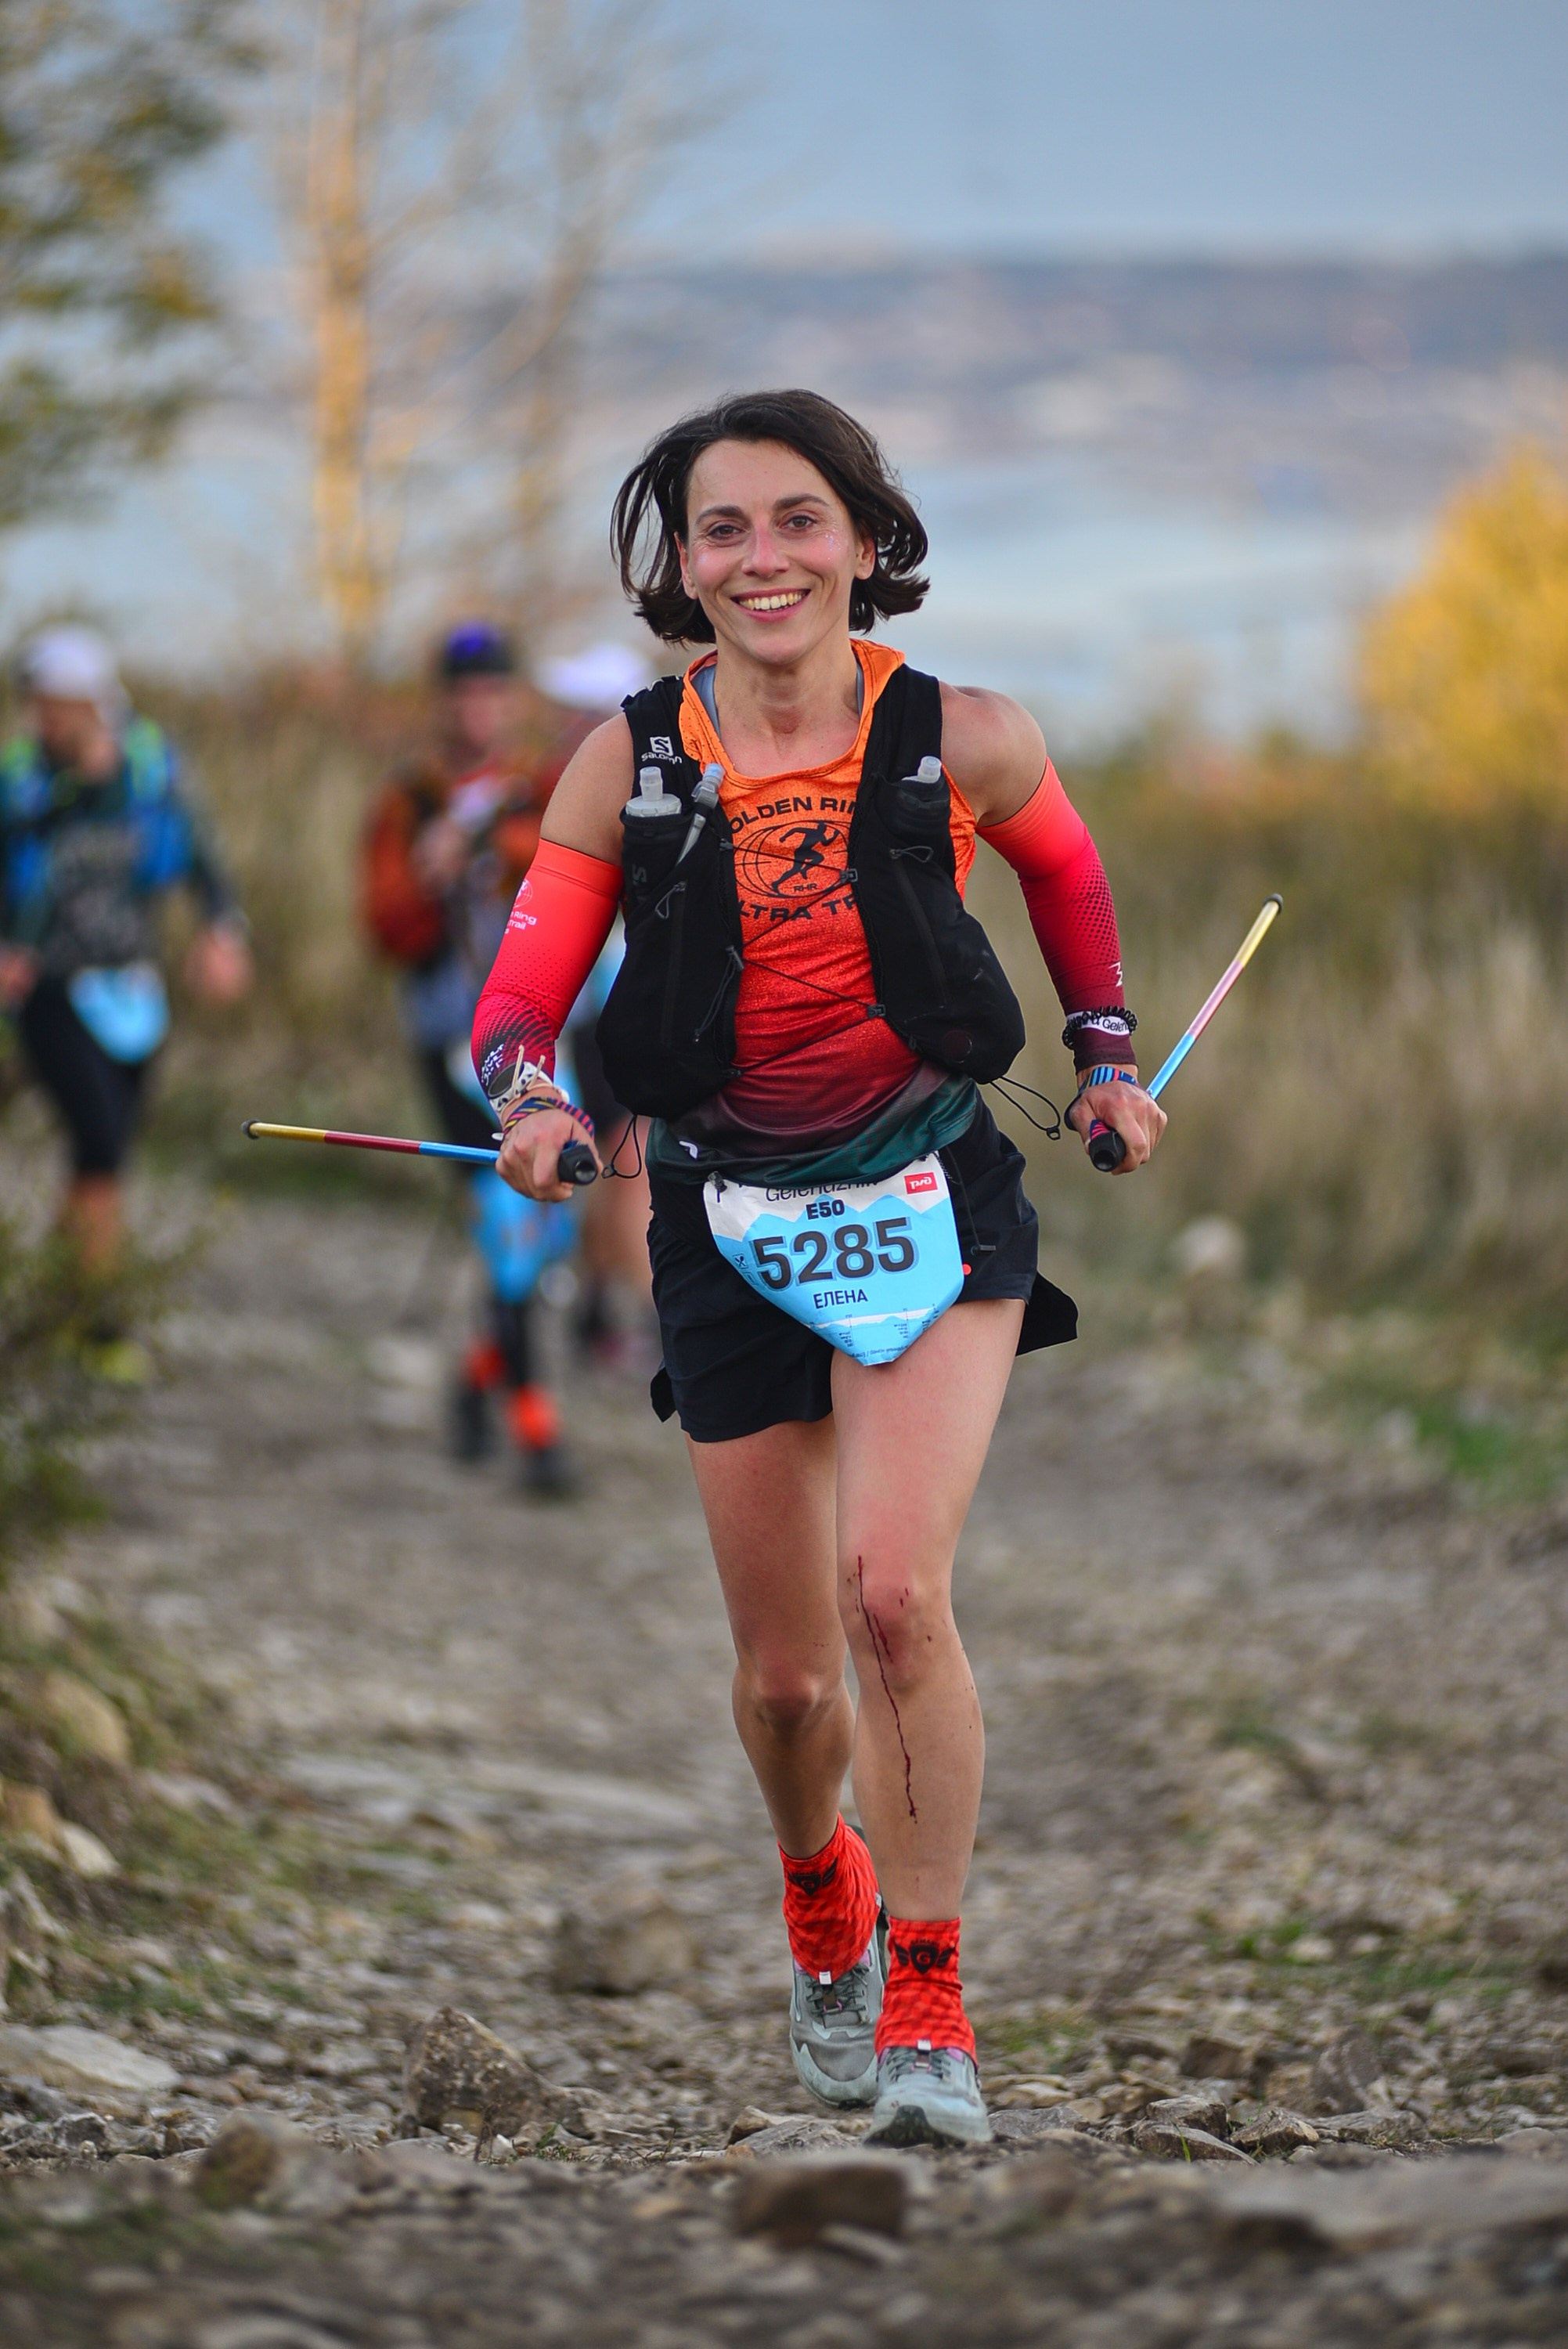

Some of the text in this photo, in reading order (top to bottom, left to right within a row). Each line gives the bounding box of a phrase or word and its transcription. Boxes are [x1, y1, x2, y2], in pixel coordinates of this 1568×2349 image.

[729, 796, 813, 834] OLDEN
[794, 883, 817, 893] RHR
[514, 911, 537, 926] Ring
[739, 900, 812, 921] LTRA
[806, 1199, 845, 1220] E50
[750, 1217, 917, 1291] 5285
[813, 1289, 868, 1309] ЕЛЕНА
